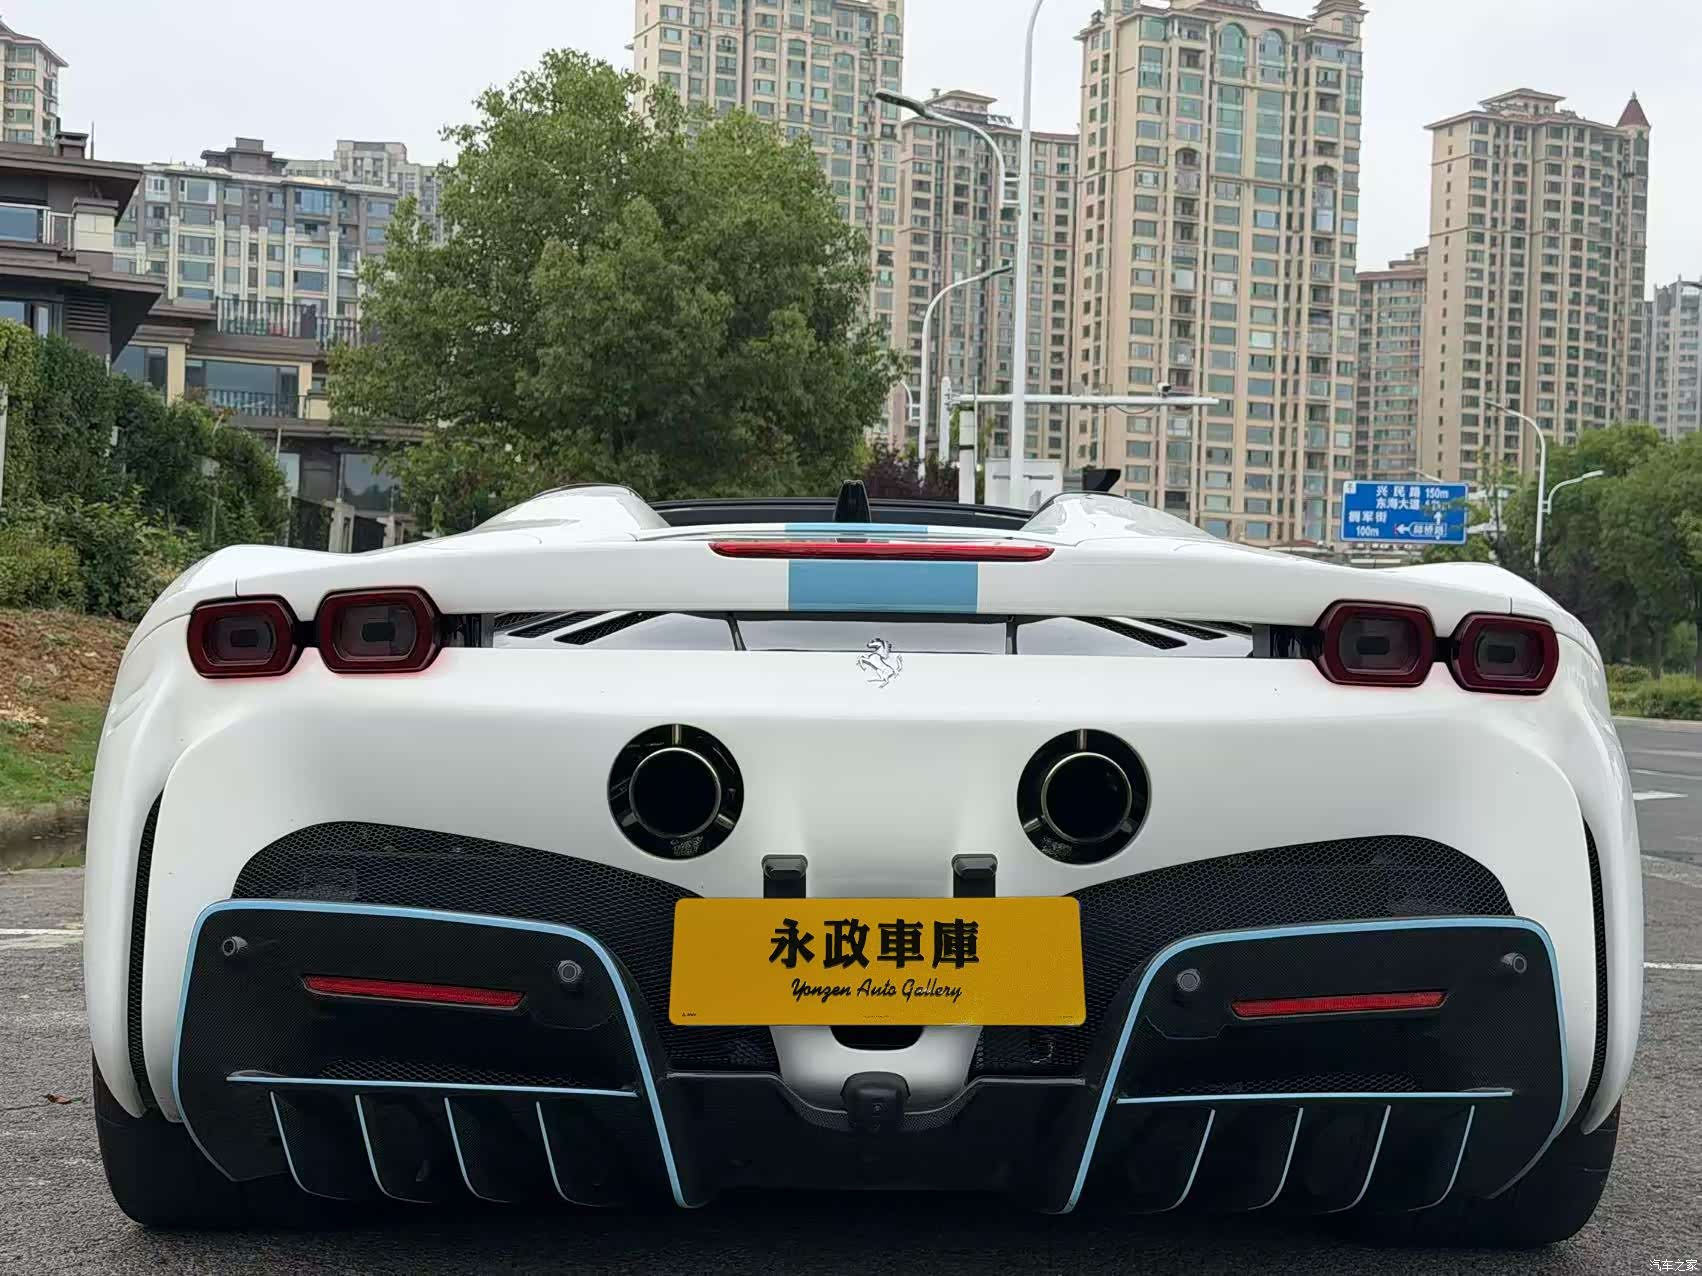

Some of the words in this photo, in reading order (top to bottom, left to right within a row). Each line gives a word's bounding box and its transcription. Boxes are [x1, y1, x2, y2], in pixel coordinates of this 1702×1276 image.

[1425, 487, 1449, 499] 150m
[1376, 499, 1420, 510] 东海大道
[1356, 525, 1379, 537] 100m
[768, 918, 980, 969] 永政車庫
[791, 978, 851, 1003] Yonzen
[856, 978, 897, 997] Auto
[901, 977, 963, 1003] Gallery
